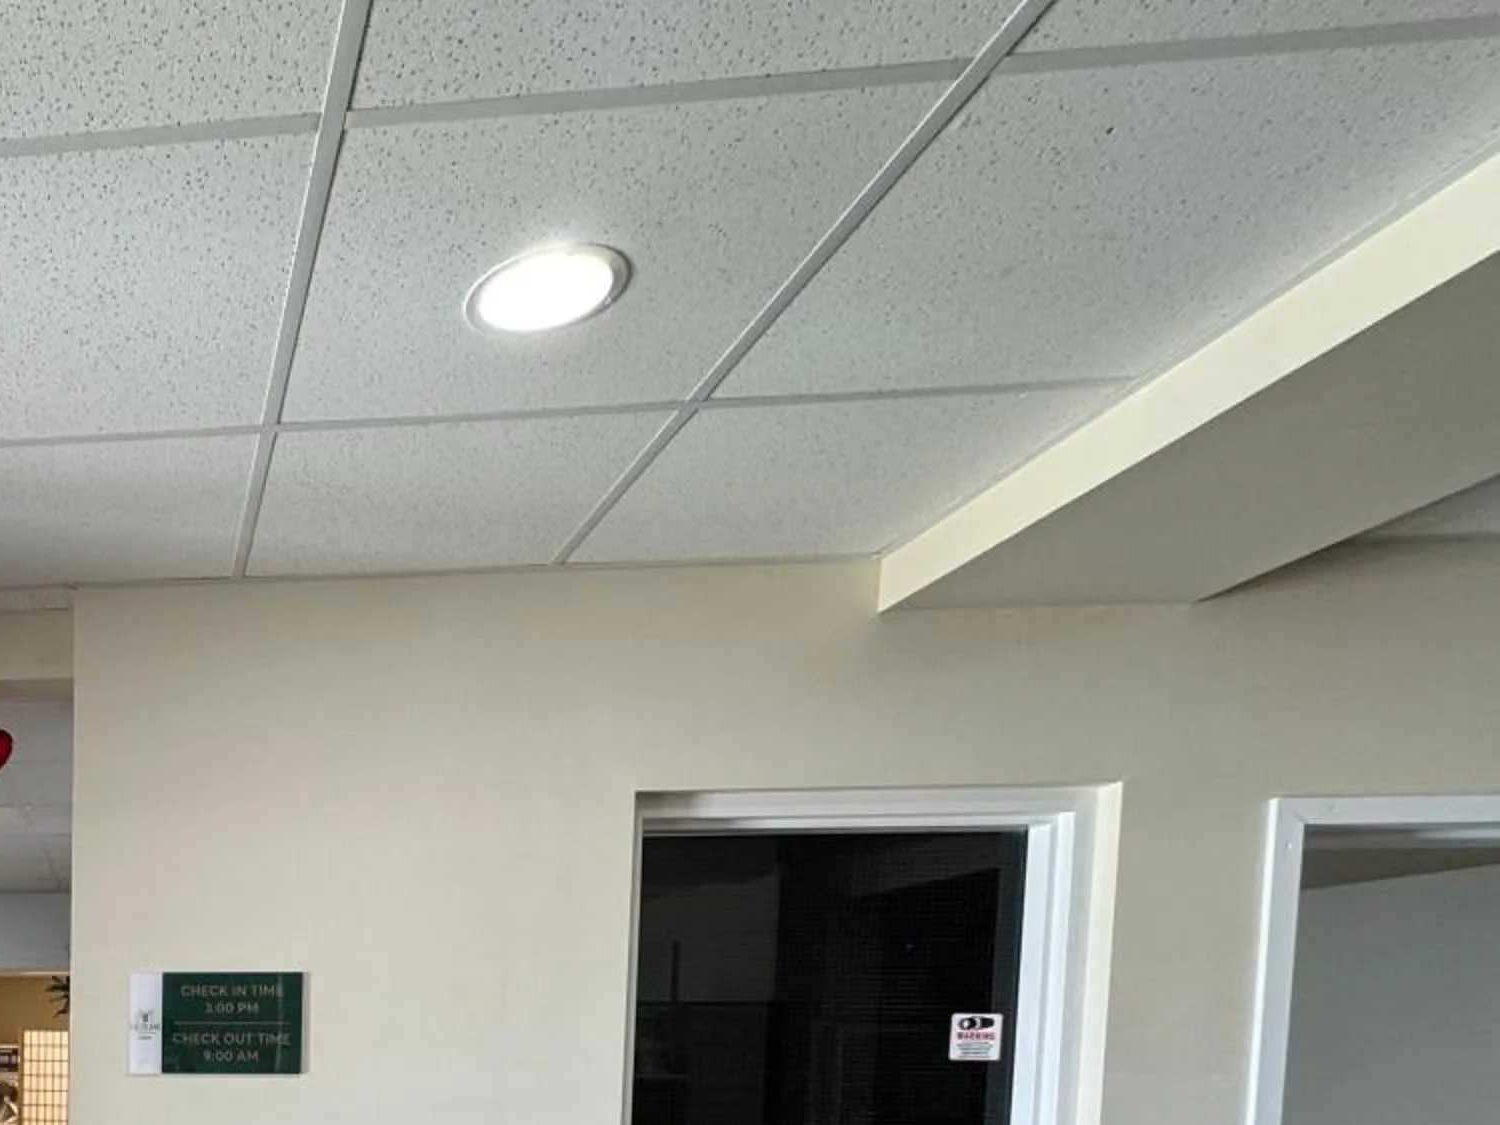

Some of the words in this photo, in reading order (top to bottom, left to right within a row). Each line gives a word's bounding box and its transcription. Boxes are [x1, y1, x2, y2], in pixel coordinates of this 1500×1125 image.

[180, 985, 228, 997] CHECK
[232, 985, 247, 997] IN
[251, 985, 283, 998] TIME
[237, 1002, 259, 1014] PM
[172, 1033, 220, 1045] CHECK
[223, 1033, 252, 1046] OUT
[258, 1033, 291, 1047] TIME
[957, 1031, 996, 1041] WARNING
[237, 1050, 259, 1062] AM
